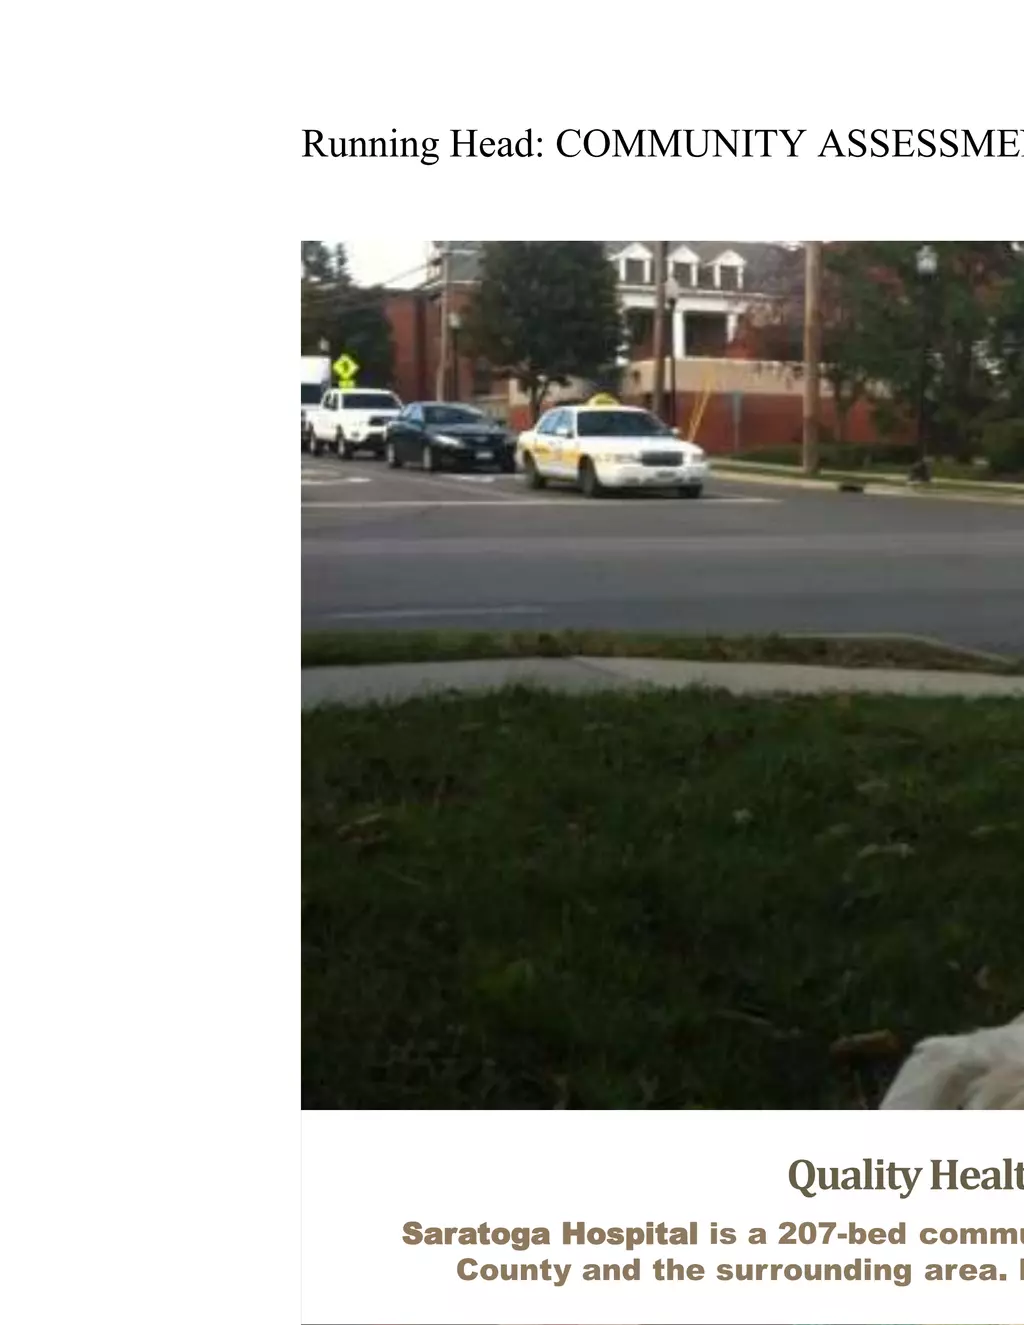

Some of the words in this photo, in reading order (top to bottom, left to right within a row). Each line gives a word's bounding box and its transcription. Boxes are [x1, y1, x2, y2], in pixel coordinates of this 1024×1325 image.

[302, 128, 439, 165] Running
[450, 128, 542, 157] Head:
[557, 128, 807, 158] COMMUNITY
[788, 1157, 923, 1199] Quality
[402, 1222, 550, 1250] Saratoga
[563, 1222, 697, 1250] Hospital
[711, 1222, 736, 1245] is
[749, 1228, 766, 1245] a
[779, 1222, 905, 1245] 207-bed
[457, 1258, 571, 1286] County
[583, 1258, 640, 1280] and
[653, 1258, 704, 1280] the
[717, 1258, 911, 1286] surrounding
[925, 1264, 1006, 1281] area.
